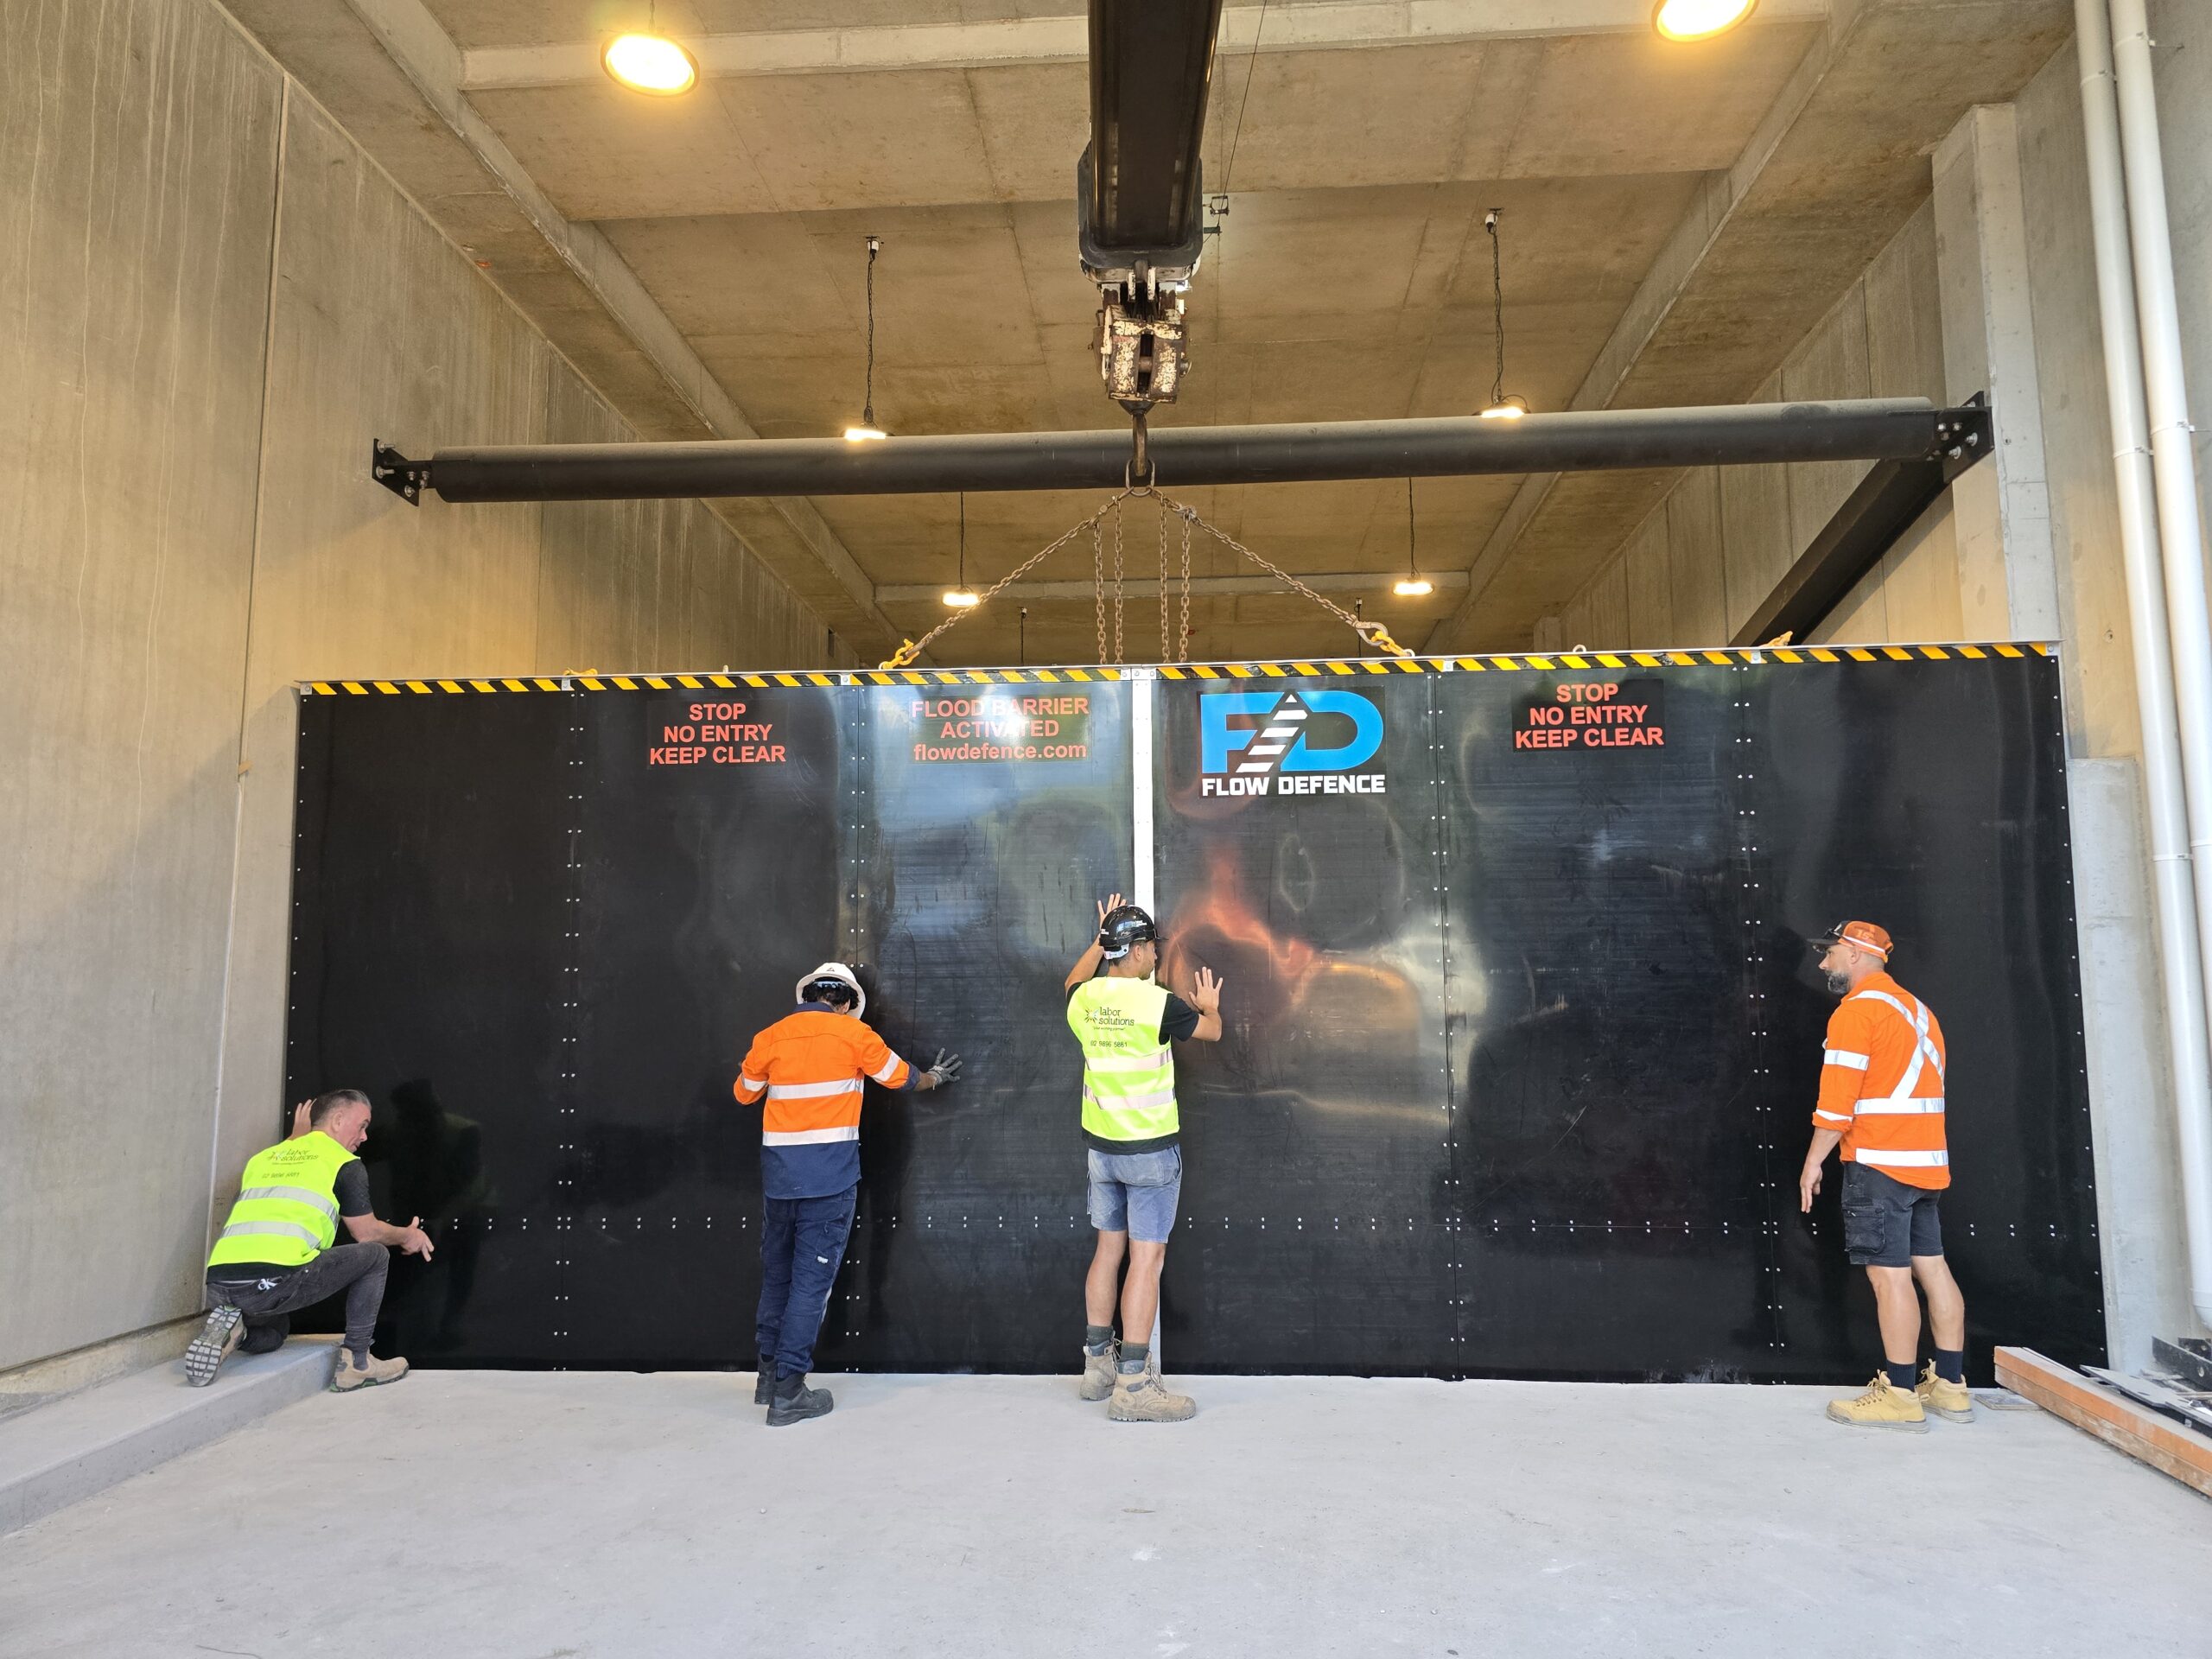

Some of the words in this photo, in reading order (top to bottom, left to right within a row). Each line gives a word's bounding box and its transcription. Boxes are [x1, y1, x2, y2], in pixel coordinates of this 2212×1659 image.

[1557, 683, 1618, 702] STOP
[690, 702, 747, 721] STOP
[912, 699, 987, 717] FLOOD
[995, 697, 1090, 716] BARRIER
[1529, 707, 1565, 726] NO
[1571, 704, 1649, 725] ENTRY
[664, 725, 696, 743] NO
[701, 723, 773, 742] ENTRY
[1516, 728, 1578, 748] KEEP
[1584, 727, 1665, 747] CLEAR
[650, 747, 707, 765] KEEP
[712, 745, 786, 764] CLEAR
[913, 743, 1088, 760] flowdefence.com
[1202, 777, 1269, 797] FLOW
[1278, 774, 1386, 795] DEFENCE
[1098, 1016, 1135, 1026] solutions
[1099, 1006, 1122, 1016] labor
